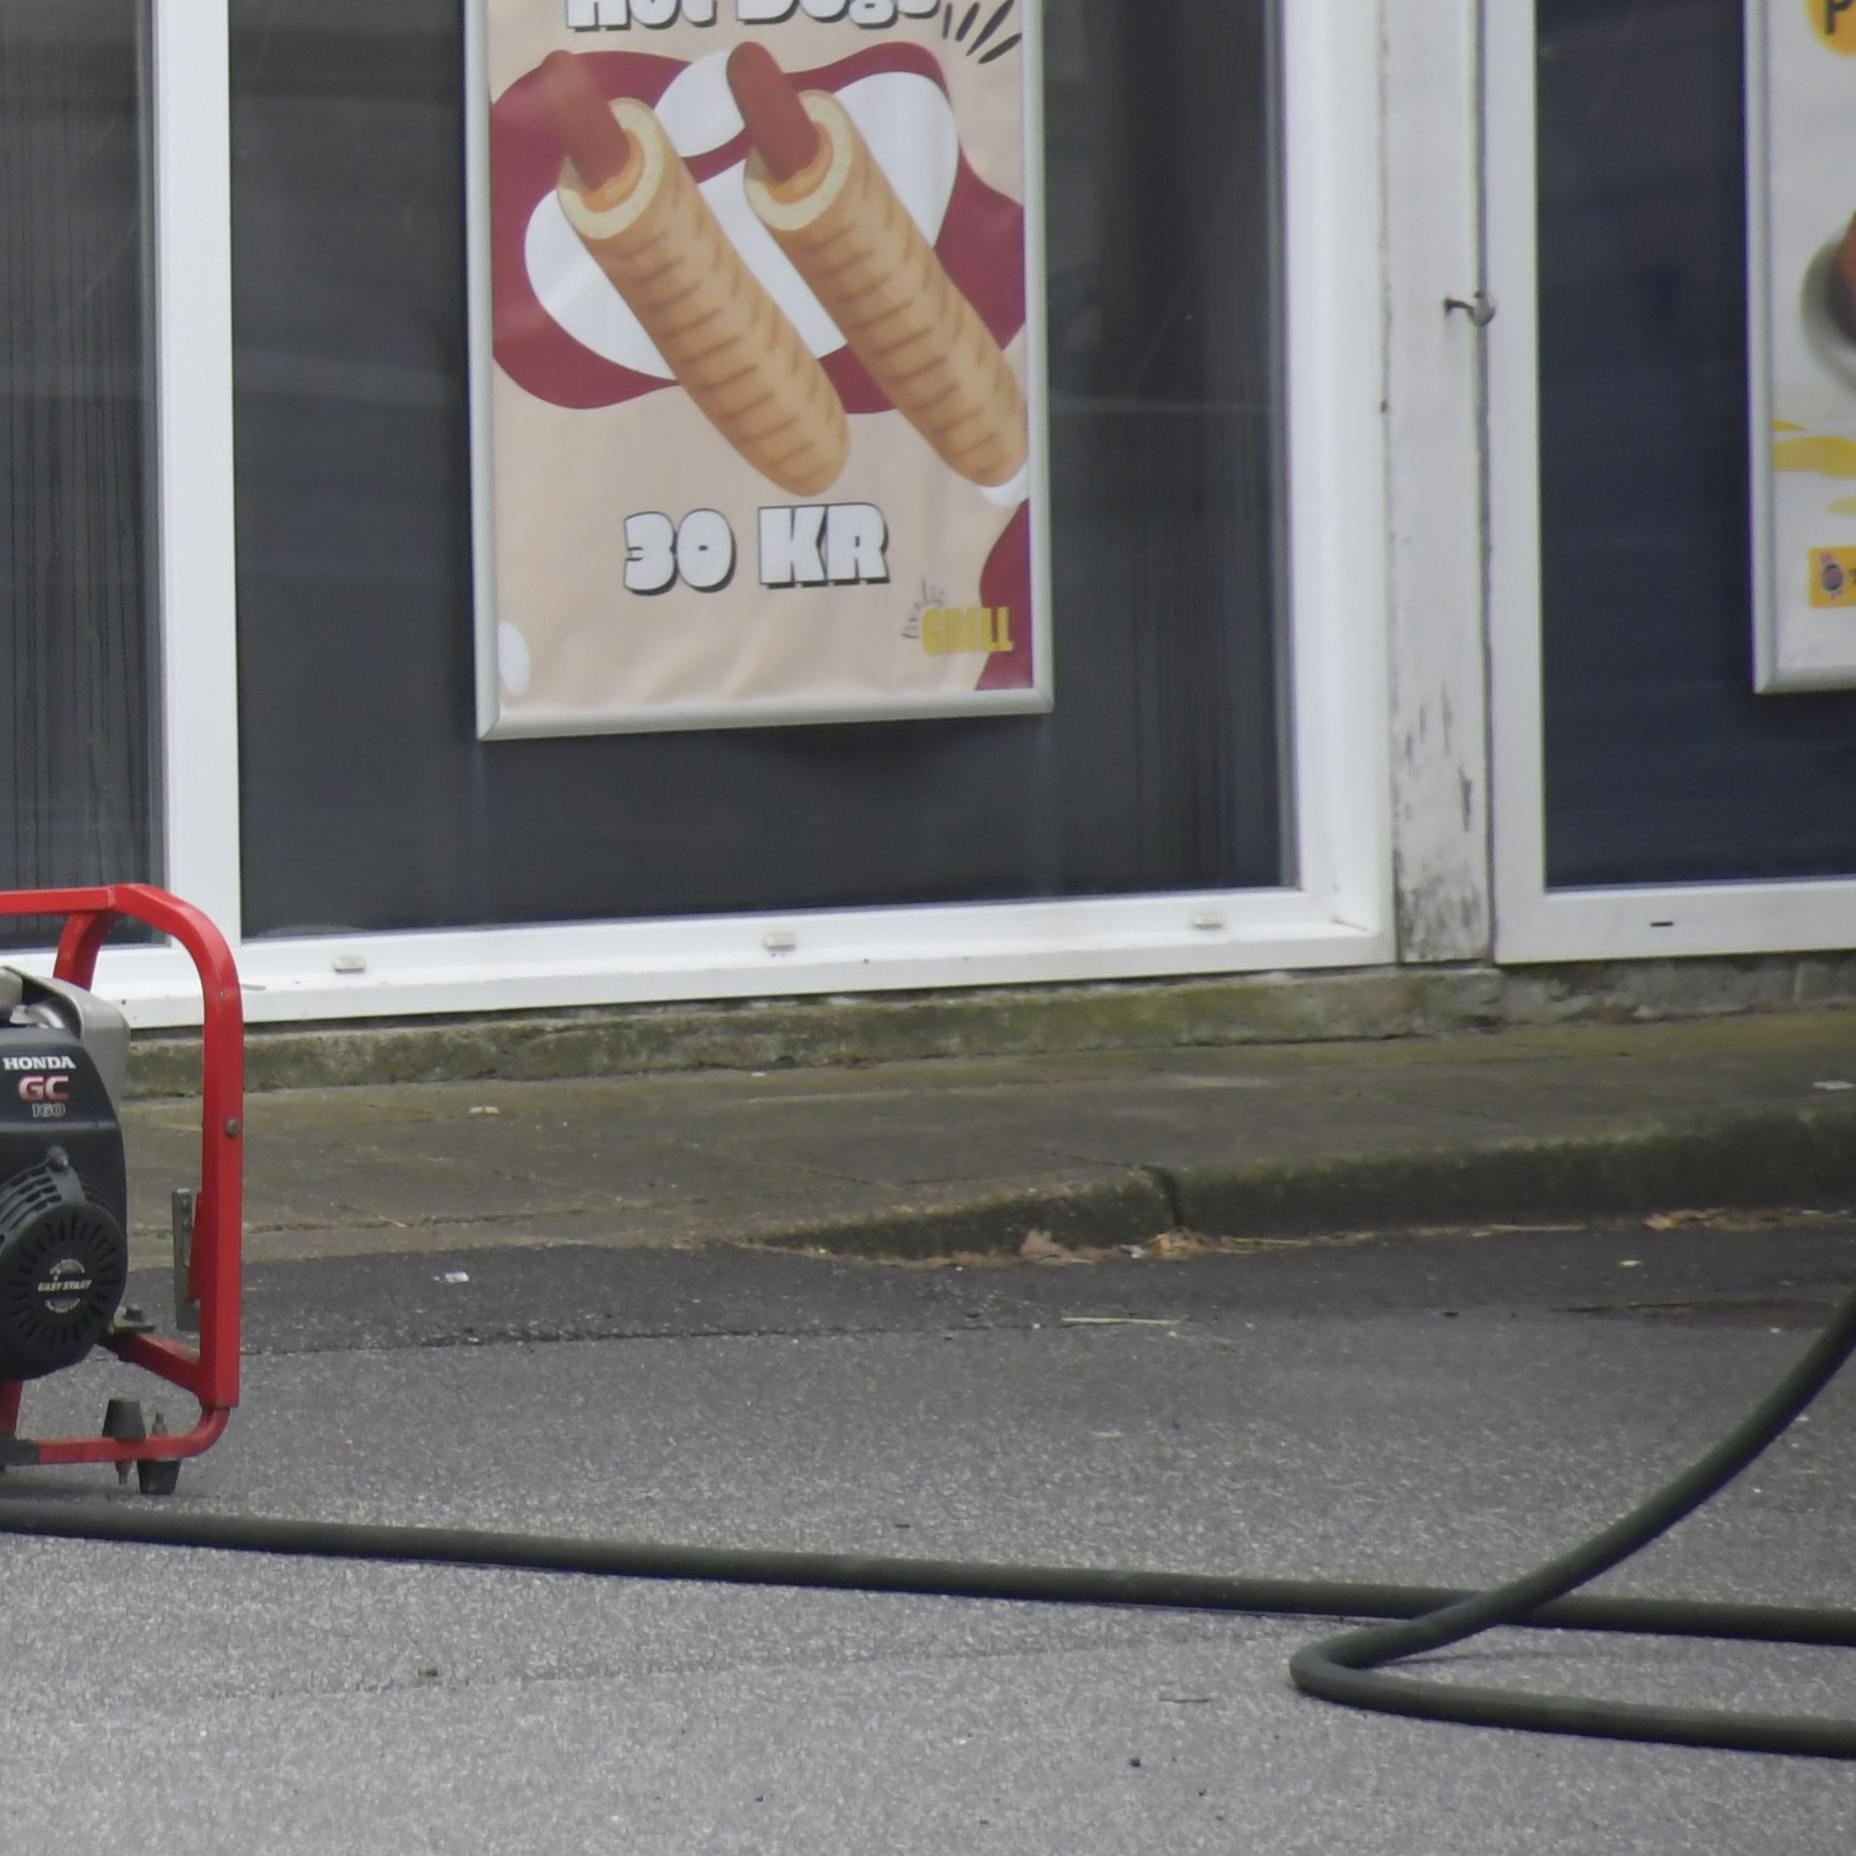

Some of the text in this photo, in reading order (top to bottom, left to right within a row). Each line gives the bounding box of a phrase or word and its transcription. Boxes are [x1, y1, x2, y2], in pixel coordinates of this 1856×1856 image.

[623, 500, 891, 595] 30 KR
[921, 605, 1015, 657] GRILL
[2, 1055, 77, 1071] HONDA
[17, 1074, 70, 1101] GC
